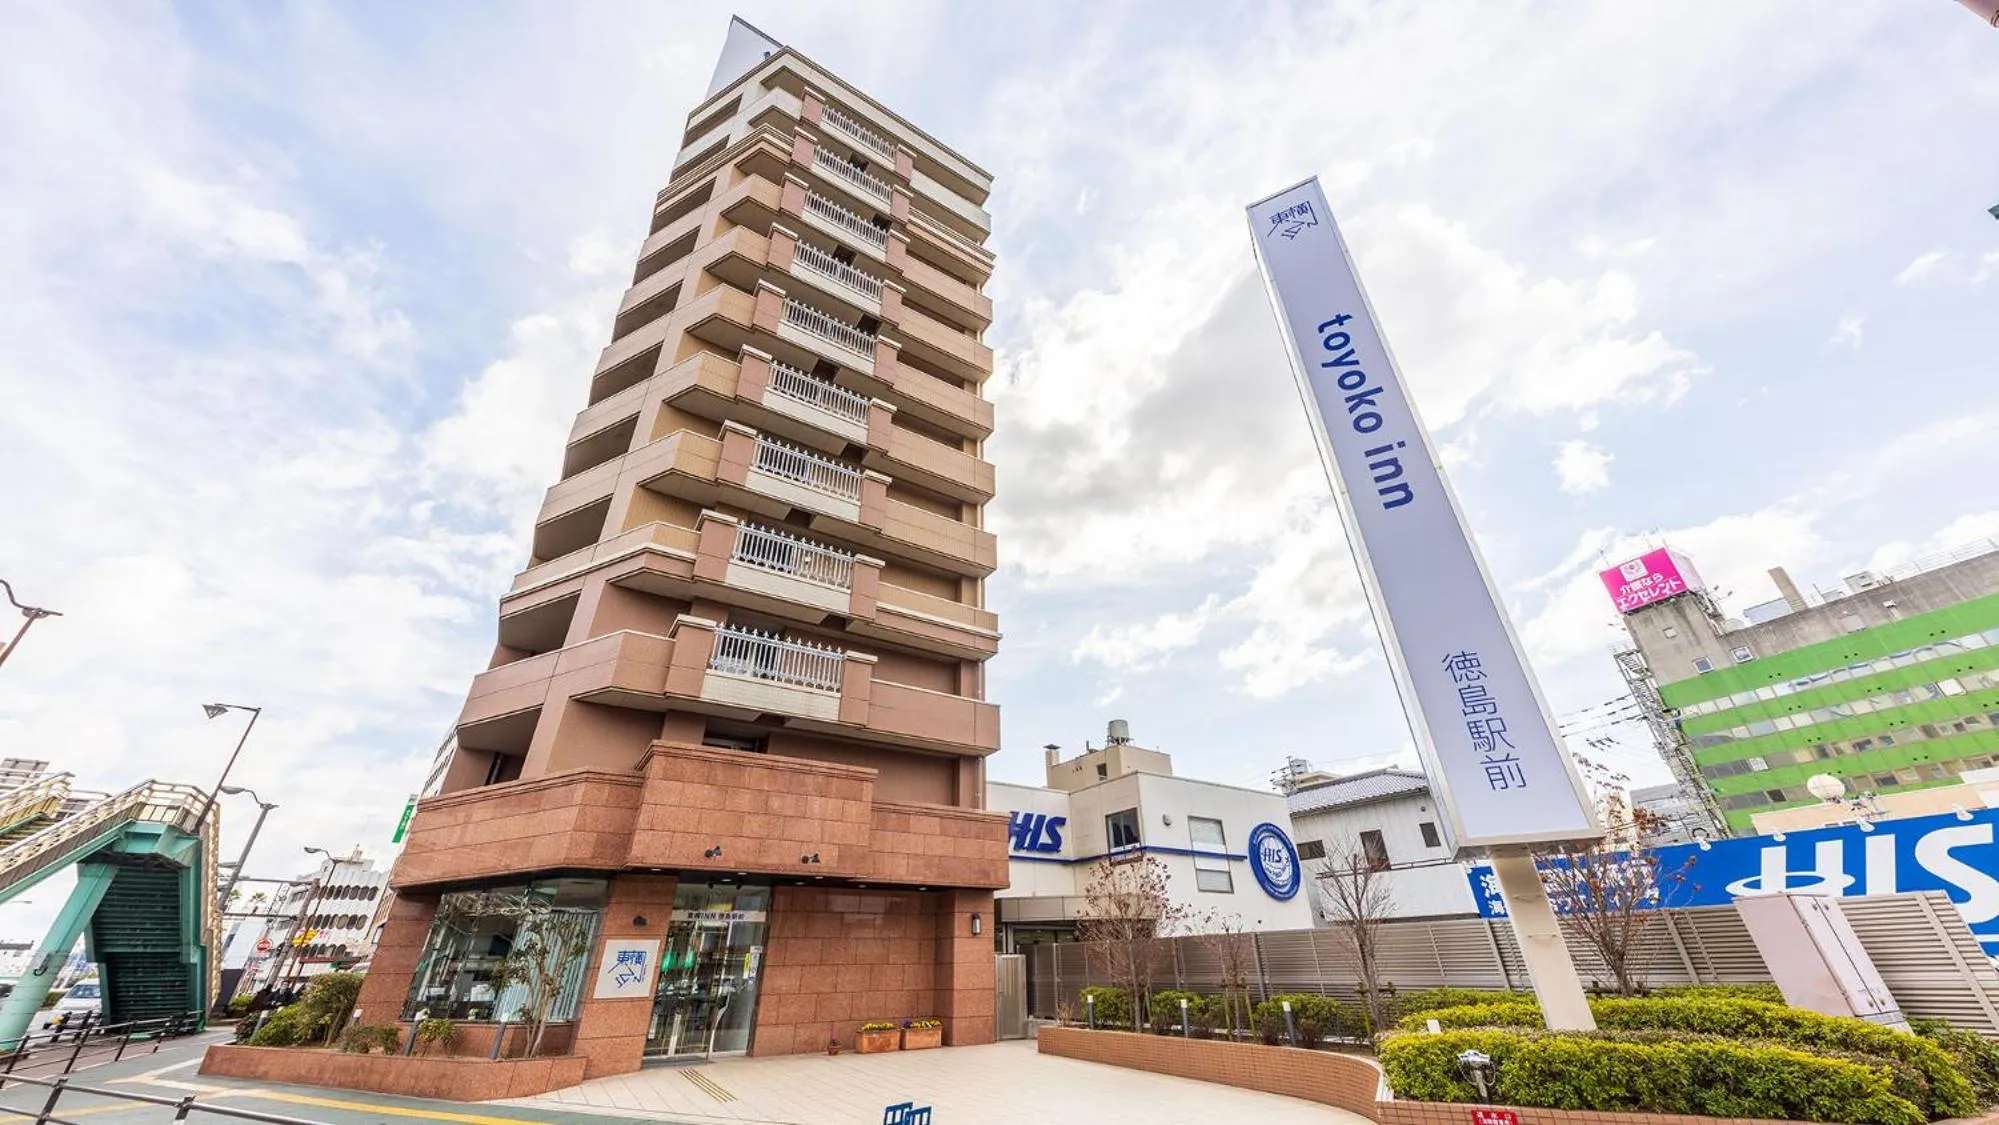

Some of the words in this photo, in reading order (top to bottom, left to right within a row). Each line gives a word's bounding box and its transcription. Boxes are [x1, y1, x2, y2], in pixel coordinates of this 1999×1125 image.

[1318, 313, 1384, 434] toyoko
[1364, 440, 1414, 510] inn
[1617, 577, 1682, 609] エクセレント
[1442, 651, 1527, 791] 徳島駅前
[1008, 811, 1067, 853] HIS
[1263, 847, 1282, 863] HIS
[1725, 822, 1999, 924] HIS
